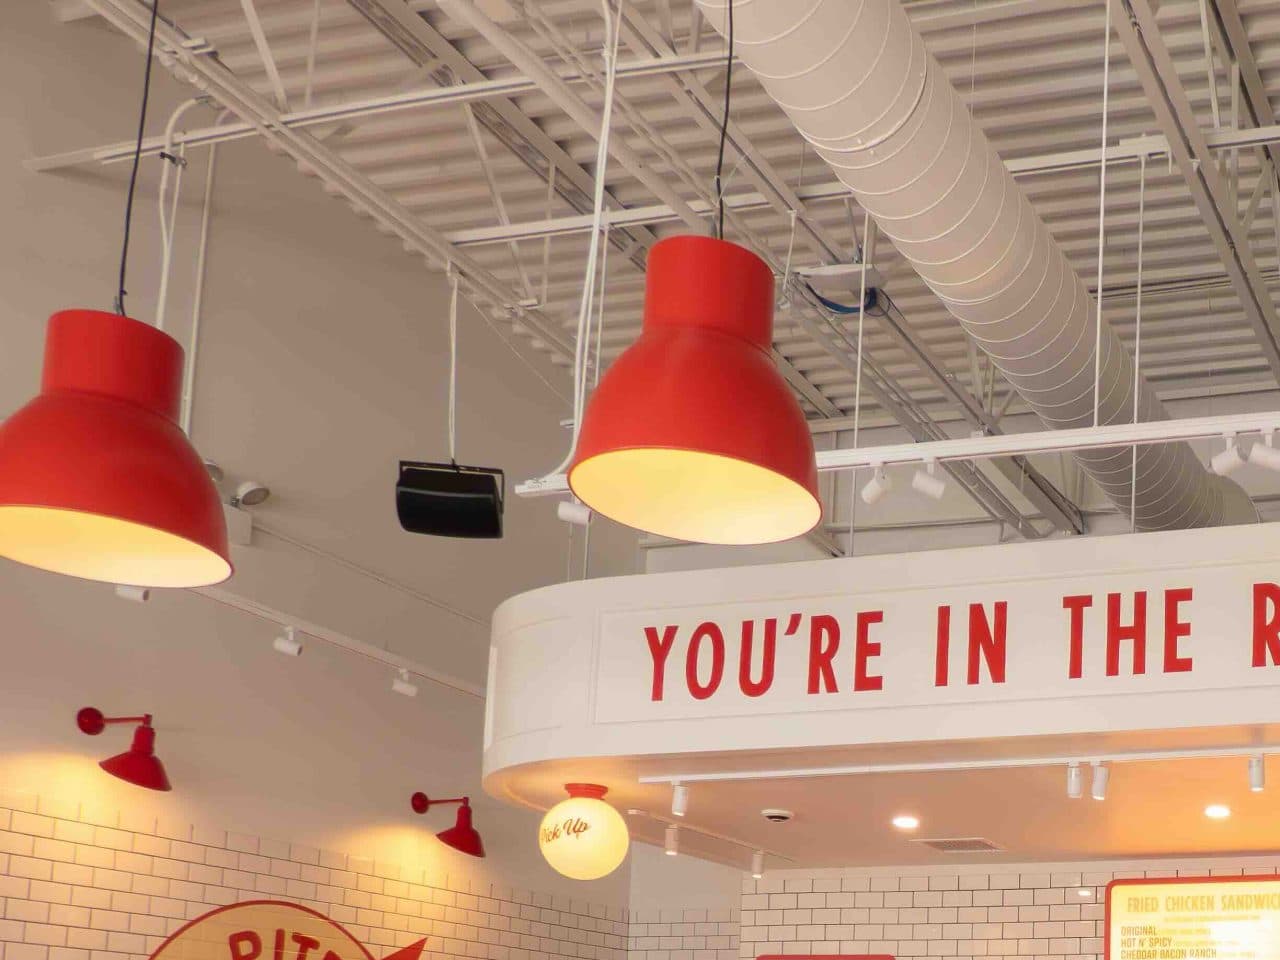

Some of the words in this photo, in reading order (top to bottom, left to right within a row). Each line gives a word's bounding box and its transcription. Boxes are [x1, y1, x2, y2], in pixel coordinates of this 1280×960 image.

[644, 610, 884, 703] YOU'RE
[934, 601, 1008, 688] IN
[1063, 587, 1195, 679] THE
[563, 818, 589, 840] Up
[1127, 895, 1160, 912] FRIED
[1165, 894, 1215, 912] CHICKEN
[1120, 926, 1158, 936] ORIGINAL
[1120, 937, 1136, 948] HOT
[1149, 936, 1173, 947] SPICY
[1120, 949, 1158, 960] CHEDDAR
[1160, 949, 1187, 959] BACON
[1189, 948, 1217, 958] RANCH
